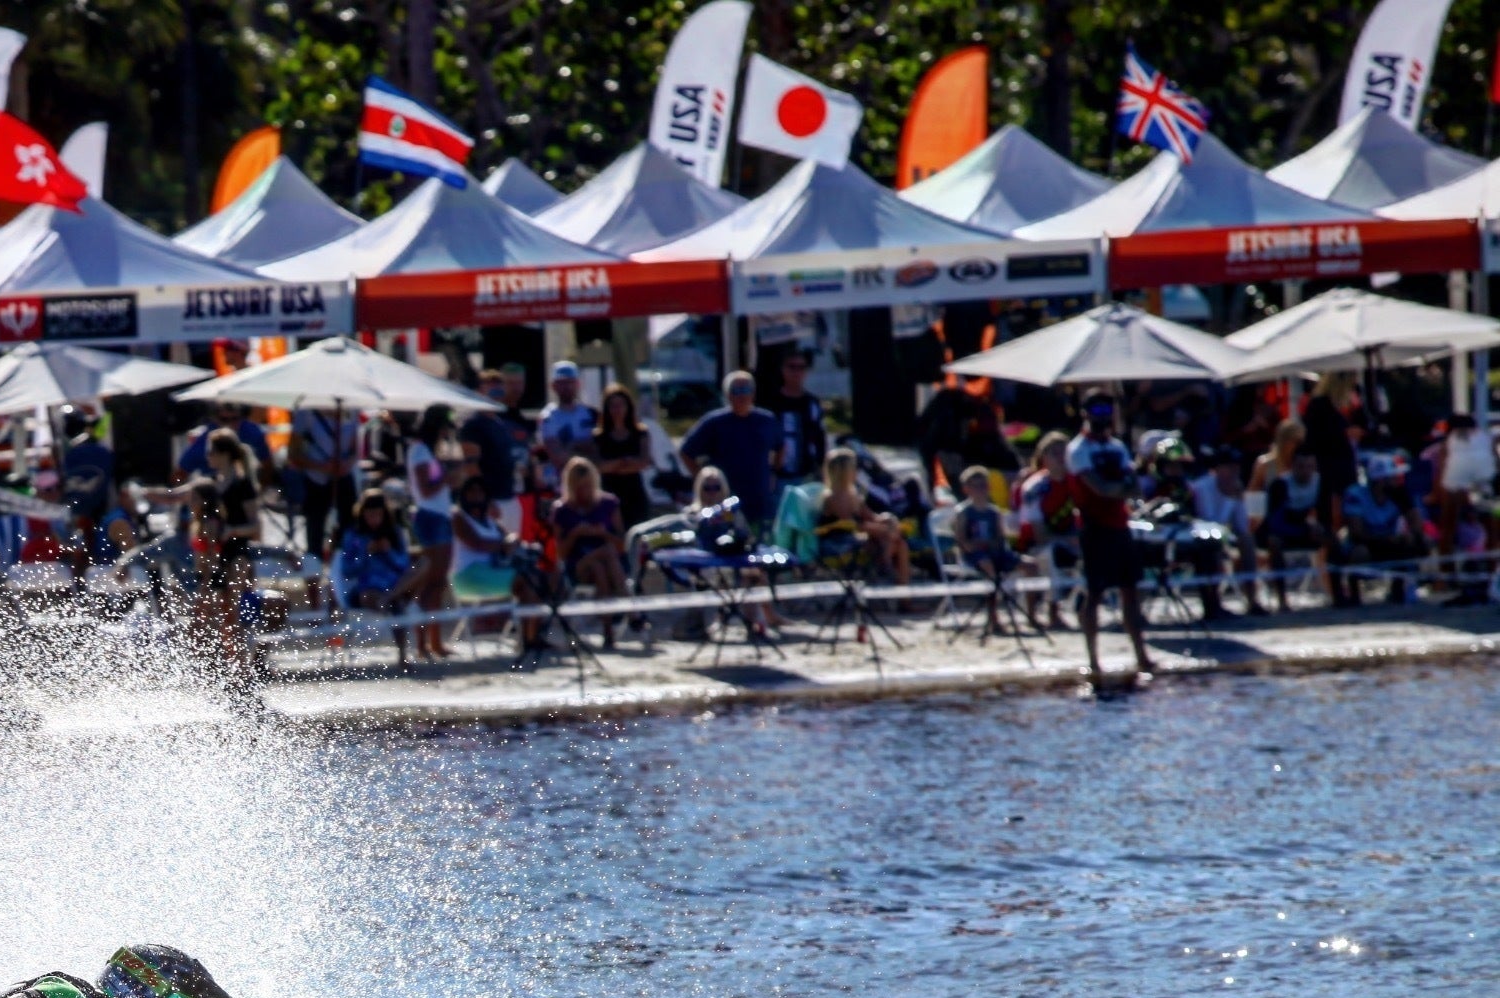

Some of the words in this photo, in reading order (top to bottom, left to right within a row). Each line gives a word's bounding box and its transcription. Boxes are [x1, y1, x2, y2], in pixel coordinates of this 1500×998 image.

[1362, 54, 1403, 111] USA
[669, 86, 706, 142] USA
[1226, 227, 1314, 263] JETSURF
[1317, 225, 1364, 257] USA
[183, 286, 277, 319] JETSURF
[280, 284, 326, 314] USA
[475, 269, 563, 305] JETSURF
[565, 266, 612, 299] USA
